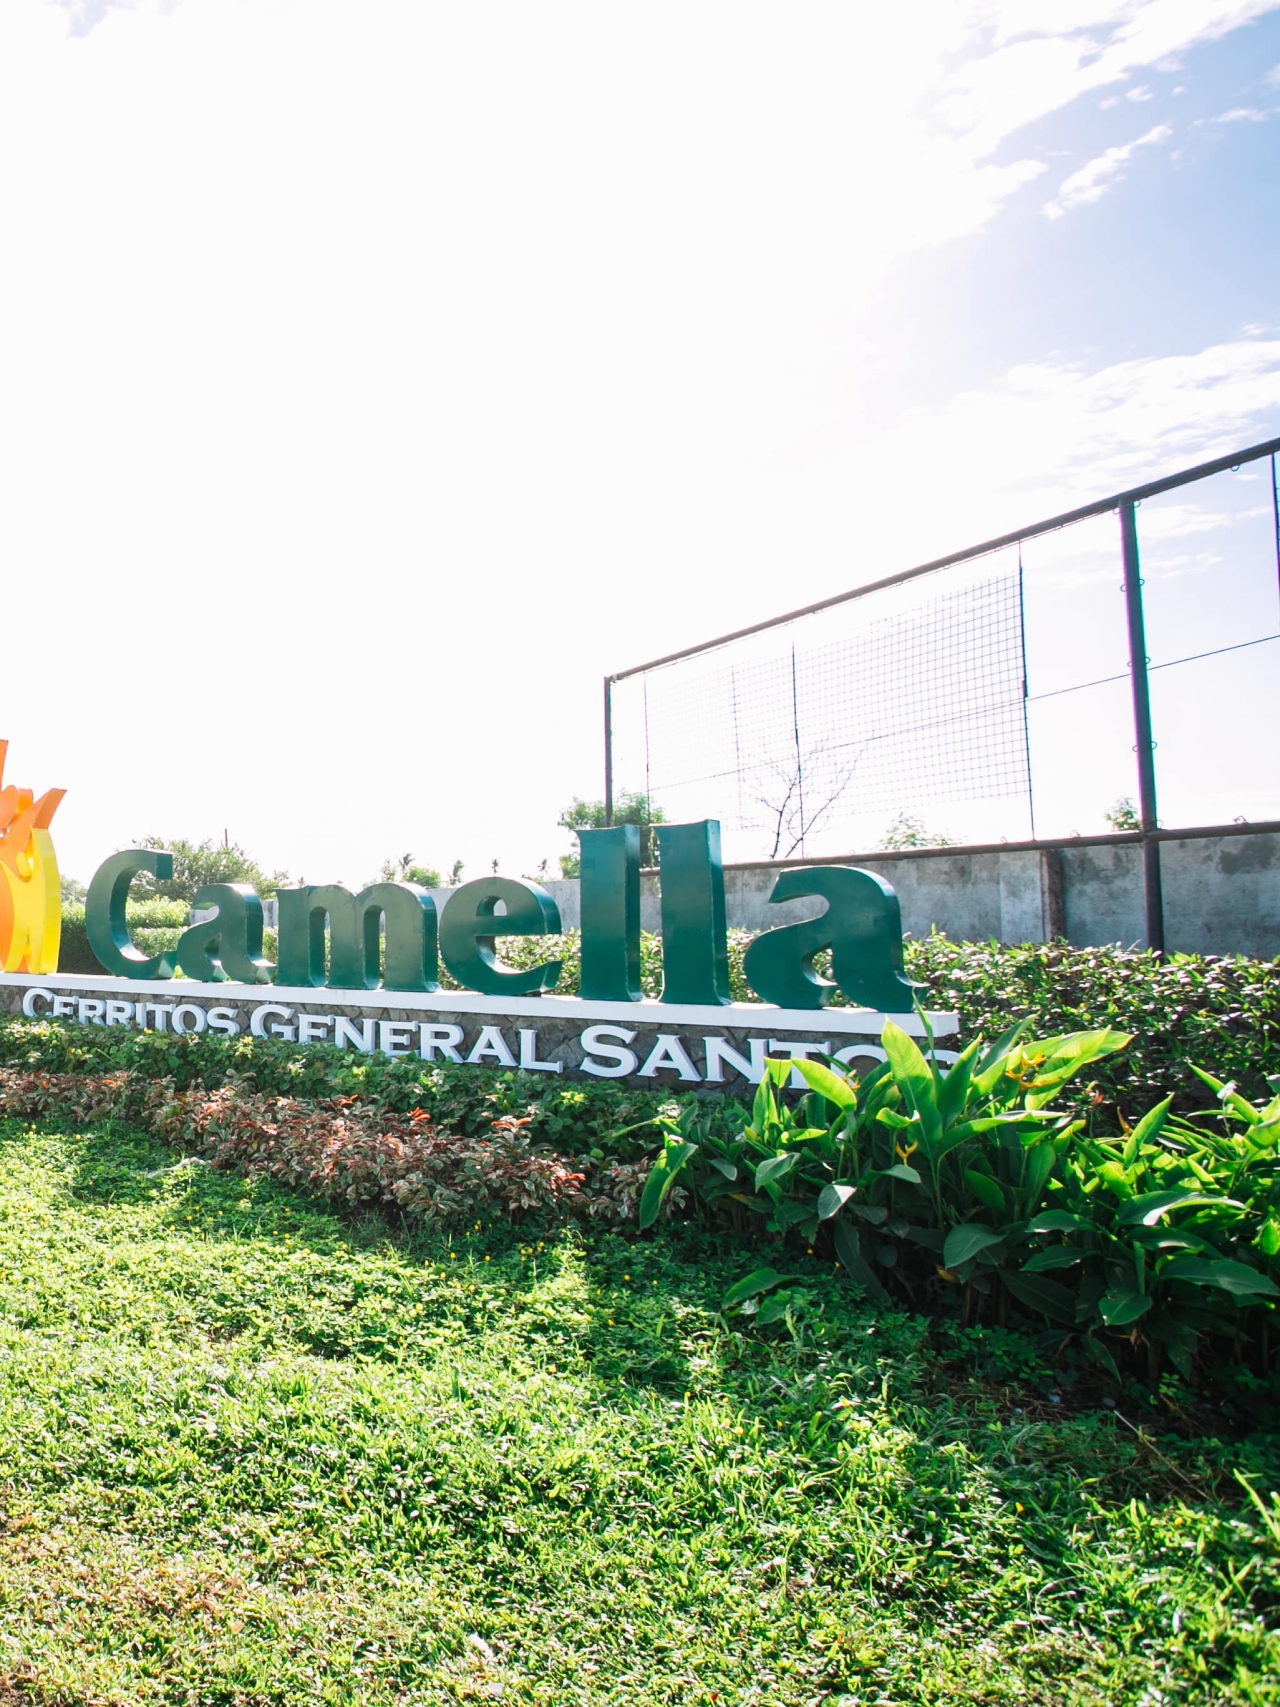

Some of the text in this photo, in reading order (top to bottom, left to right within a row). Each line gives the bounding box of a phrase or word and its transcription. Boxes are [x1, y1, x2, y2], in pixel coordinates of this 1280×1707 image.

[85, 819, 930, 1013] Camella
[22, 987, 964, 1090] CERRITOS GENERAL SANT
